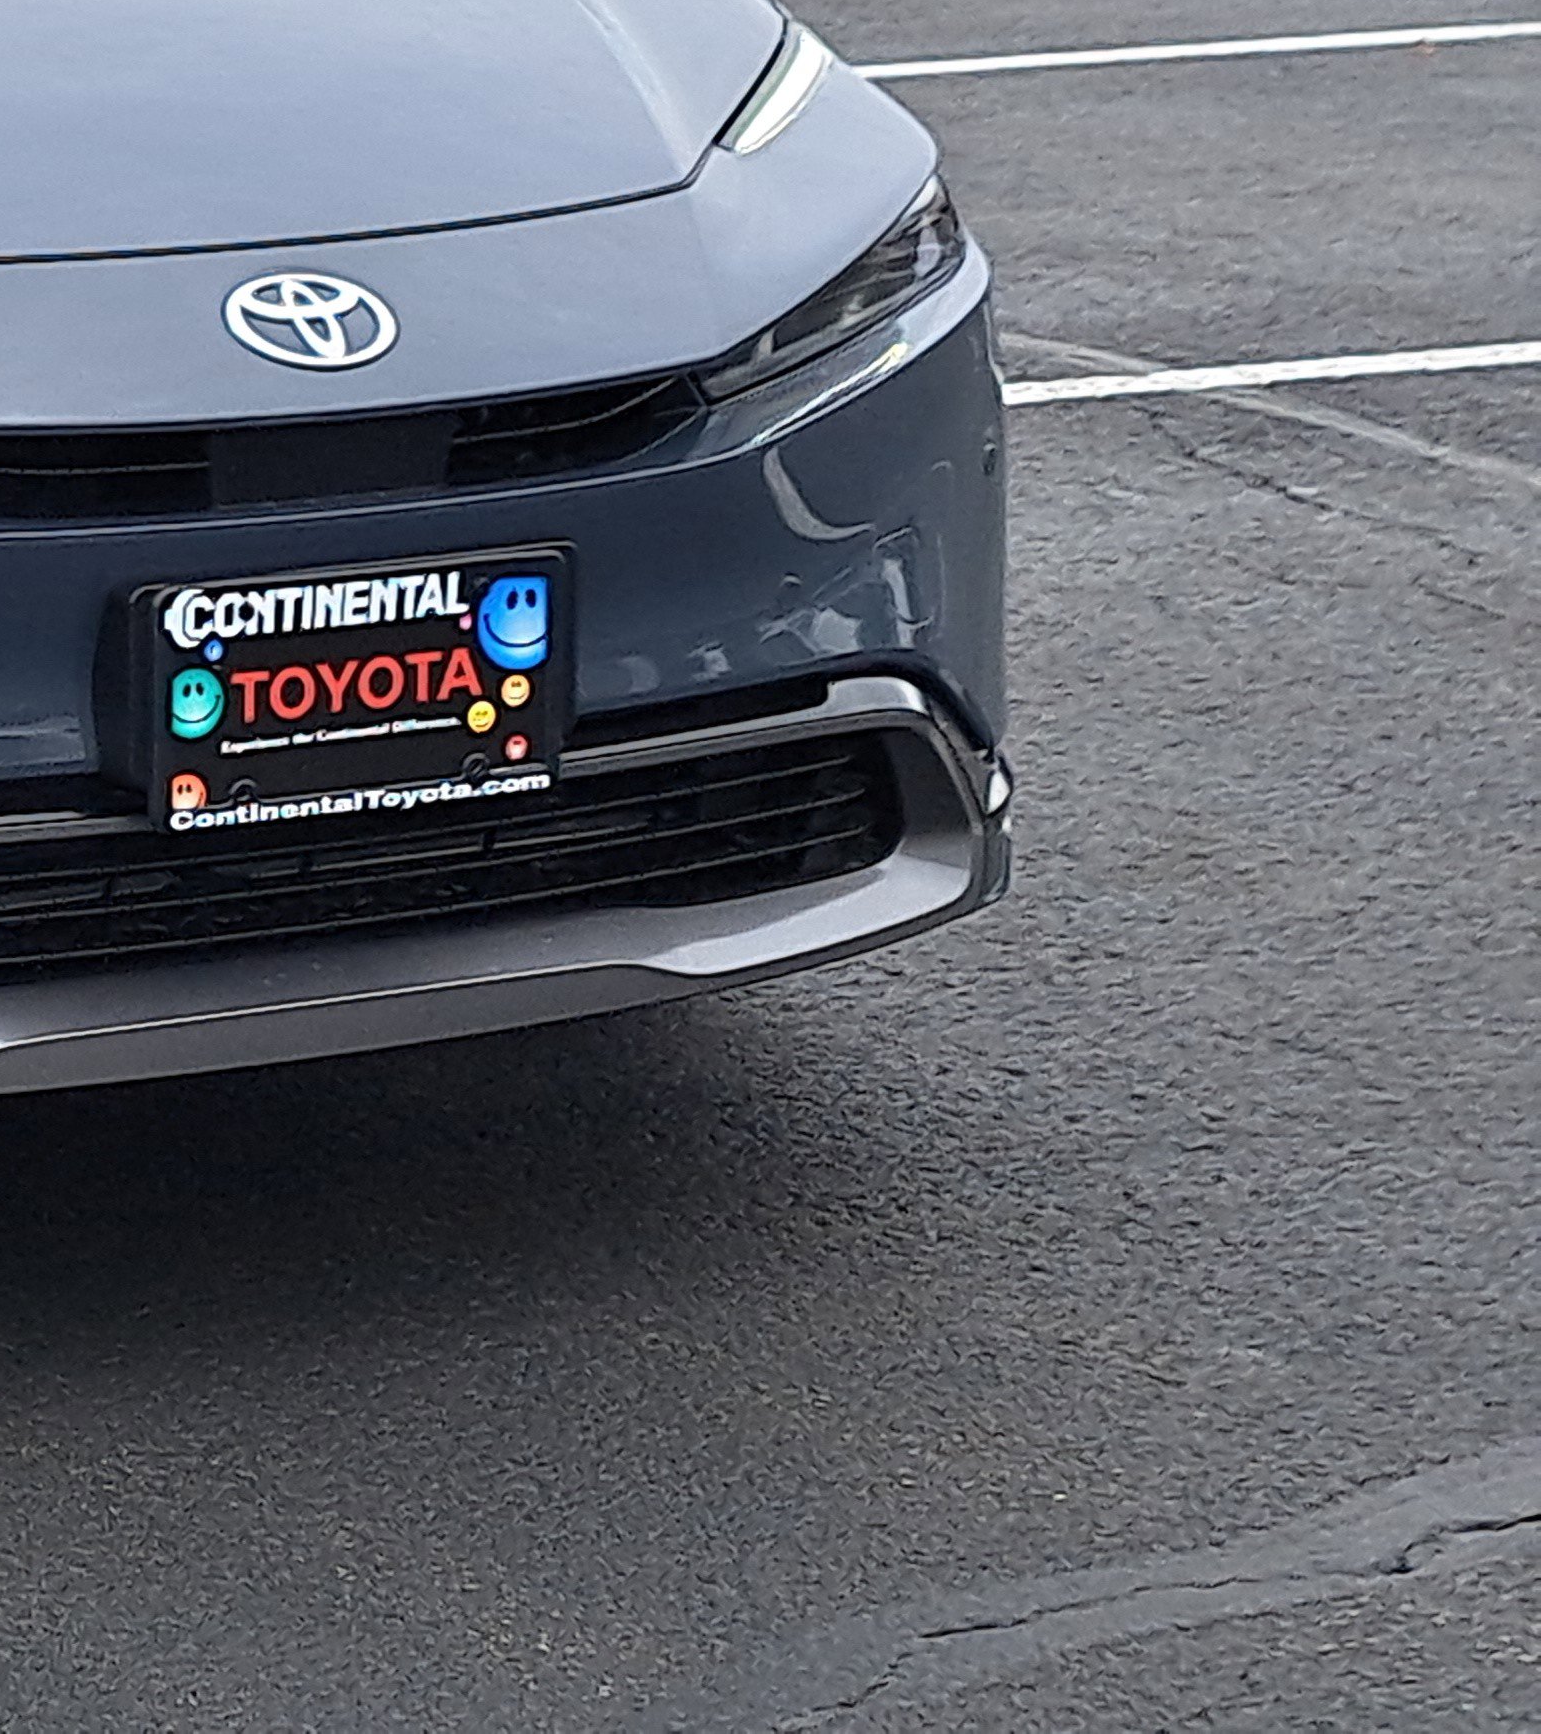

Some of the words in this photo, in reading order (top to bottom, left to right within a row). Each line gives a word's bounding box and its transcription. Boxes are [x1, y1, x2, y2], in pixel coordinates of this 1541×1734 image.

[164, 571, 471, 648] CONTINENTAL
[230, 646, 484, 725] TOYOTA
[169, 773, 552, 832] ContinentalToyota.com
